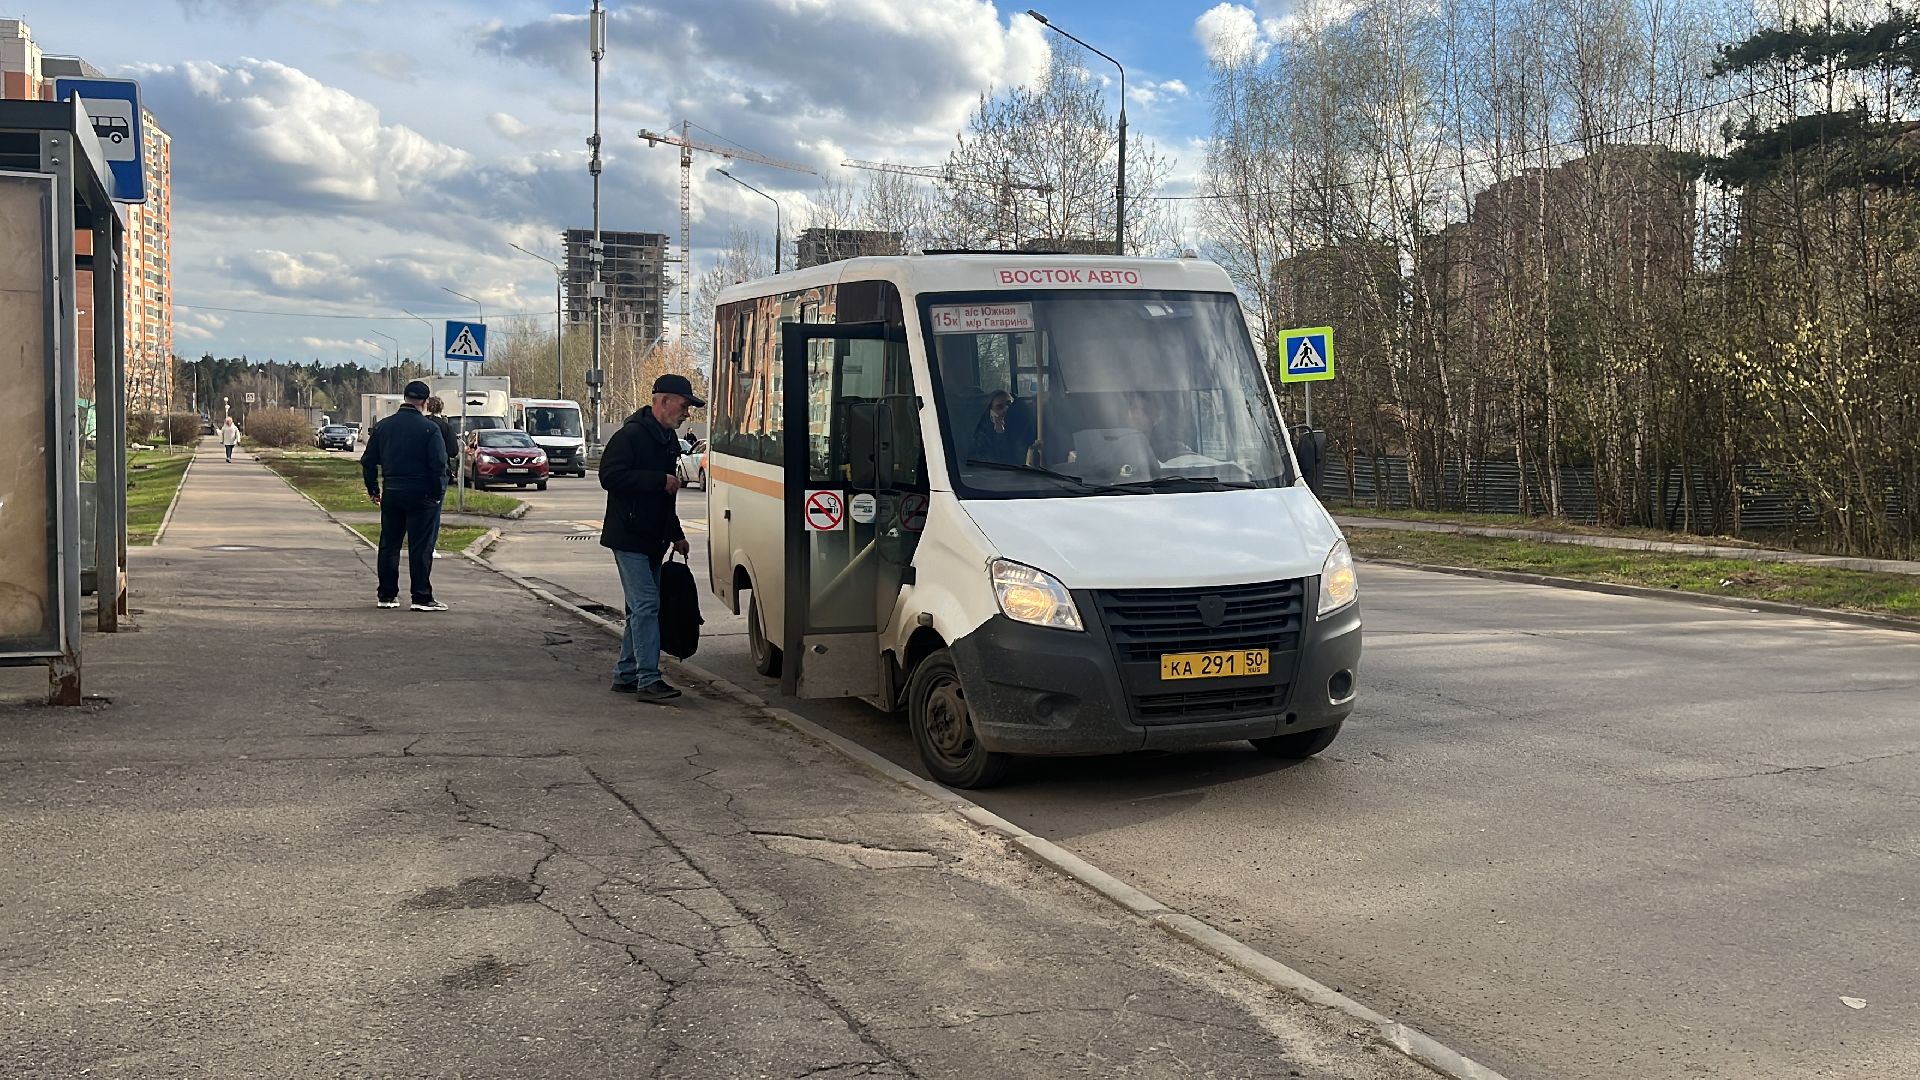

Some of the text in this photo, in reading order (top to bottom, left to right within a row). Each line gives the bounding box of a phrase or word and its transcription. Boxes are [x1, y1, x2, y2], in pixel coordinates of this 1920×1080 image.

[1000, 269, 1138, 284] ВОСТОК АВТО
[981, 306, 1016, 316] Южная
[984, 317, 1028, 328] Гагарина
[1201, 654, 1235, 675] 291
[1245, 651, 1263, 666] 50
